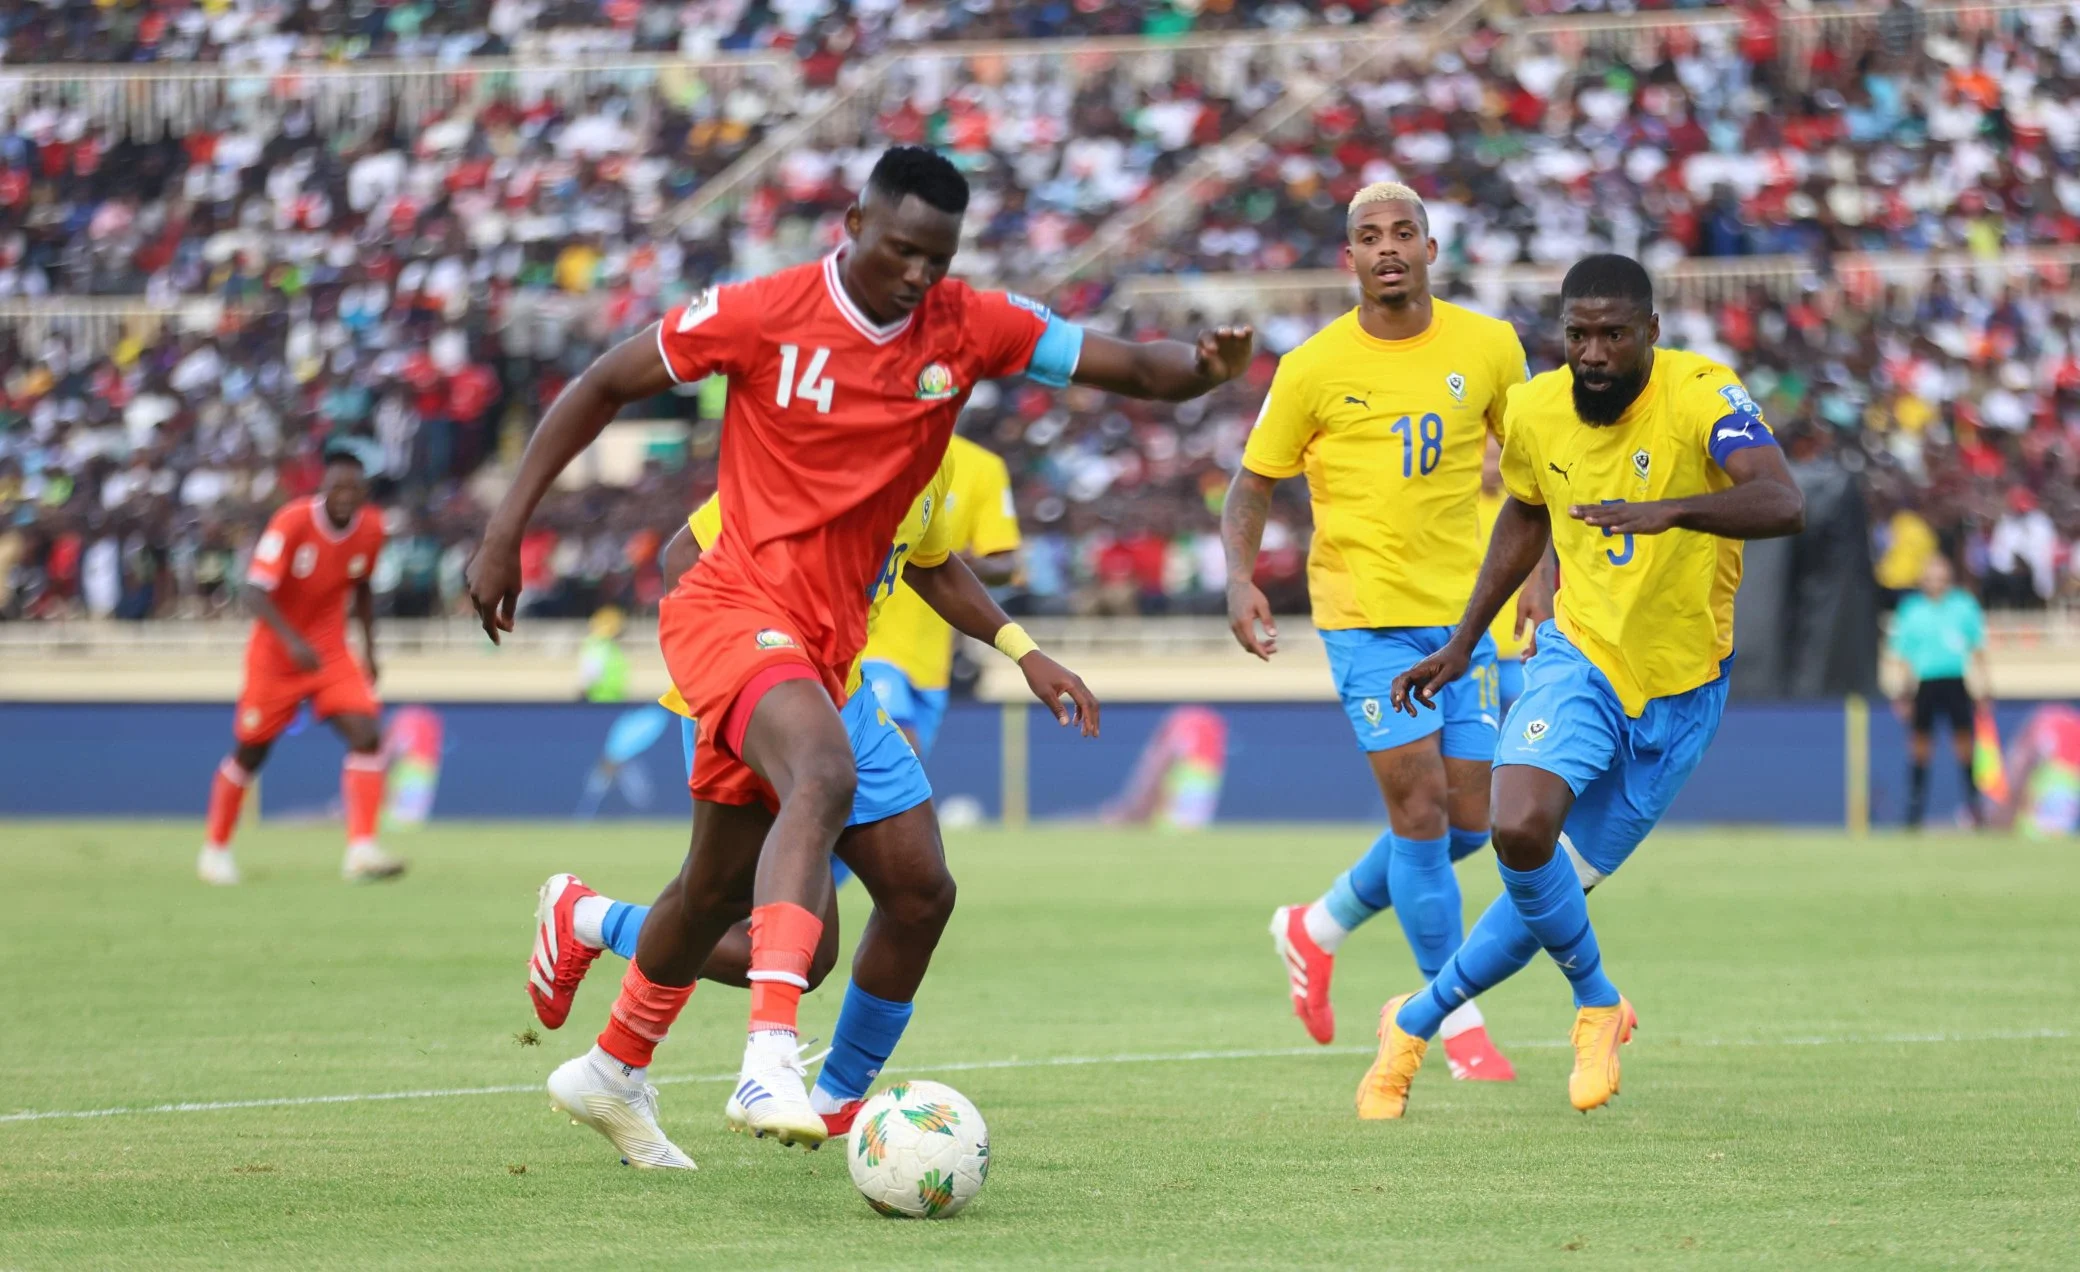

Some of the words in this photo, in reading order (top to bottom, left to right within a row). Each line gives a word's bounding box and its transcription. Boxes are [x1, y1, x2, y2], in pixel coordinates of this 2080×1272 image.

[775, 343, 834, 414] 14
[1391, 412, 1443, 478] 18
[1601, 499, 1634, 566] 5
